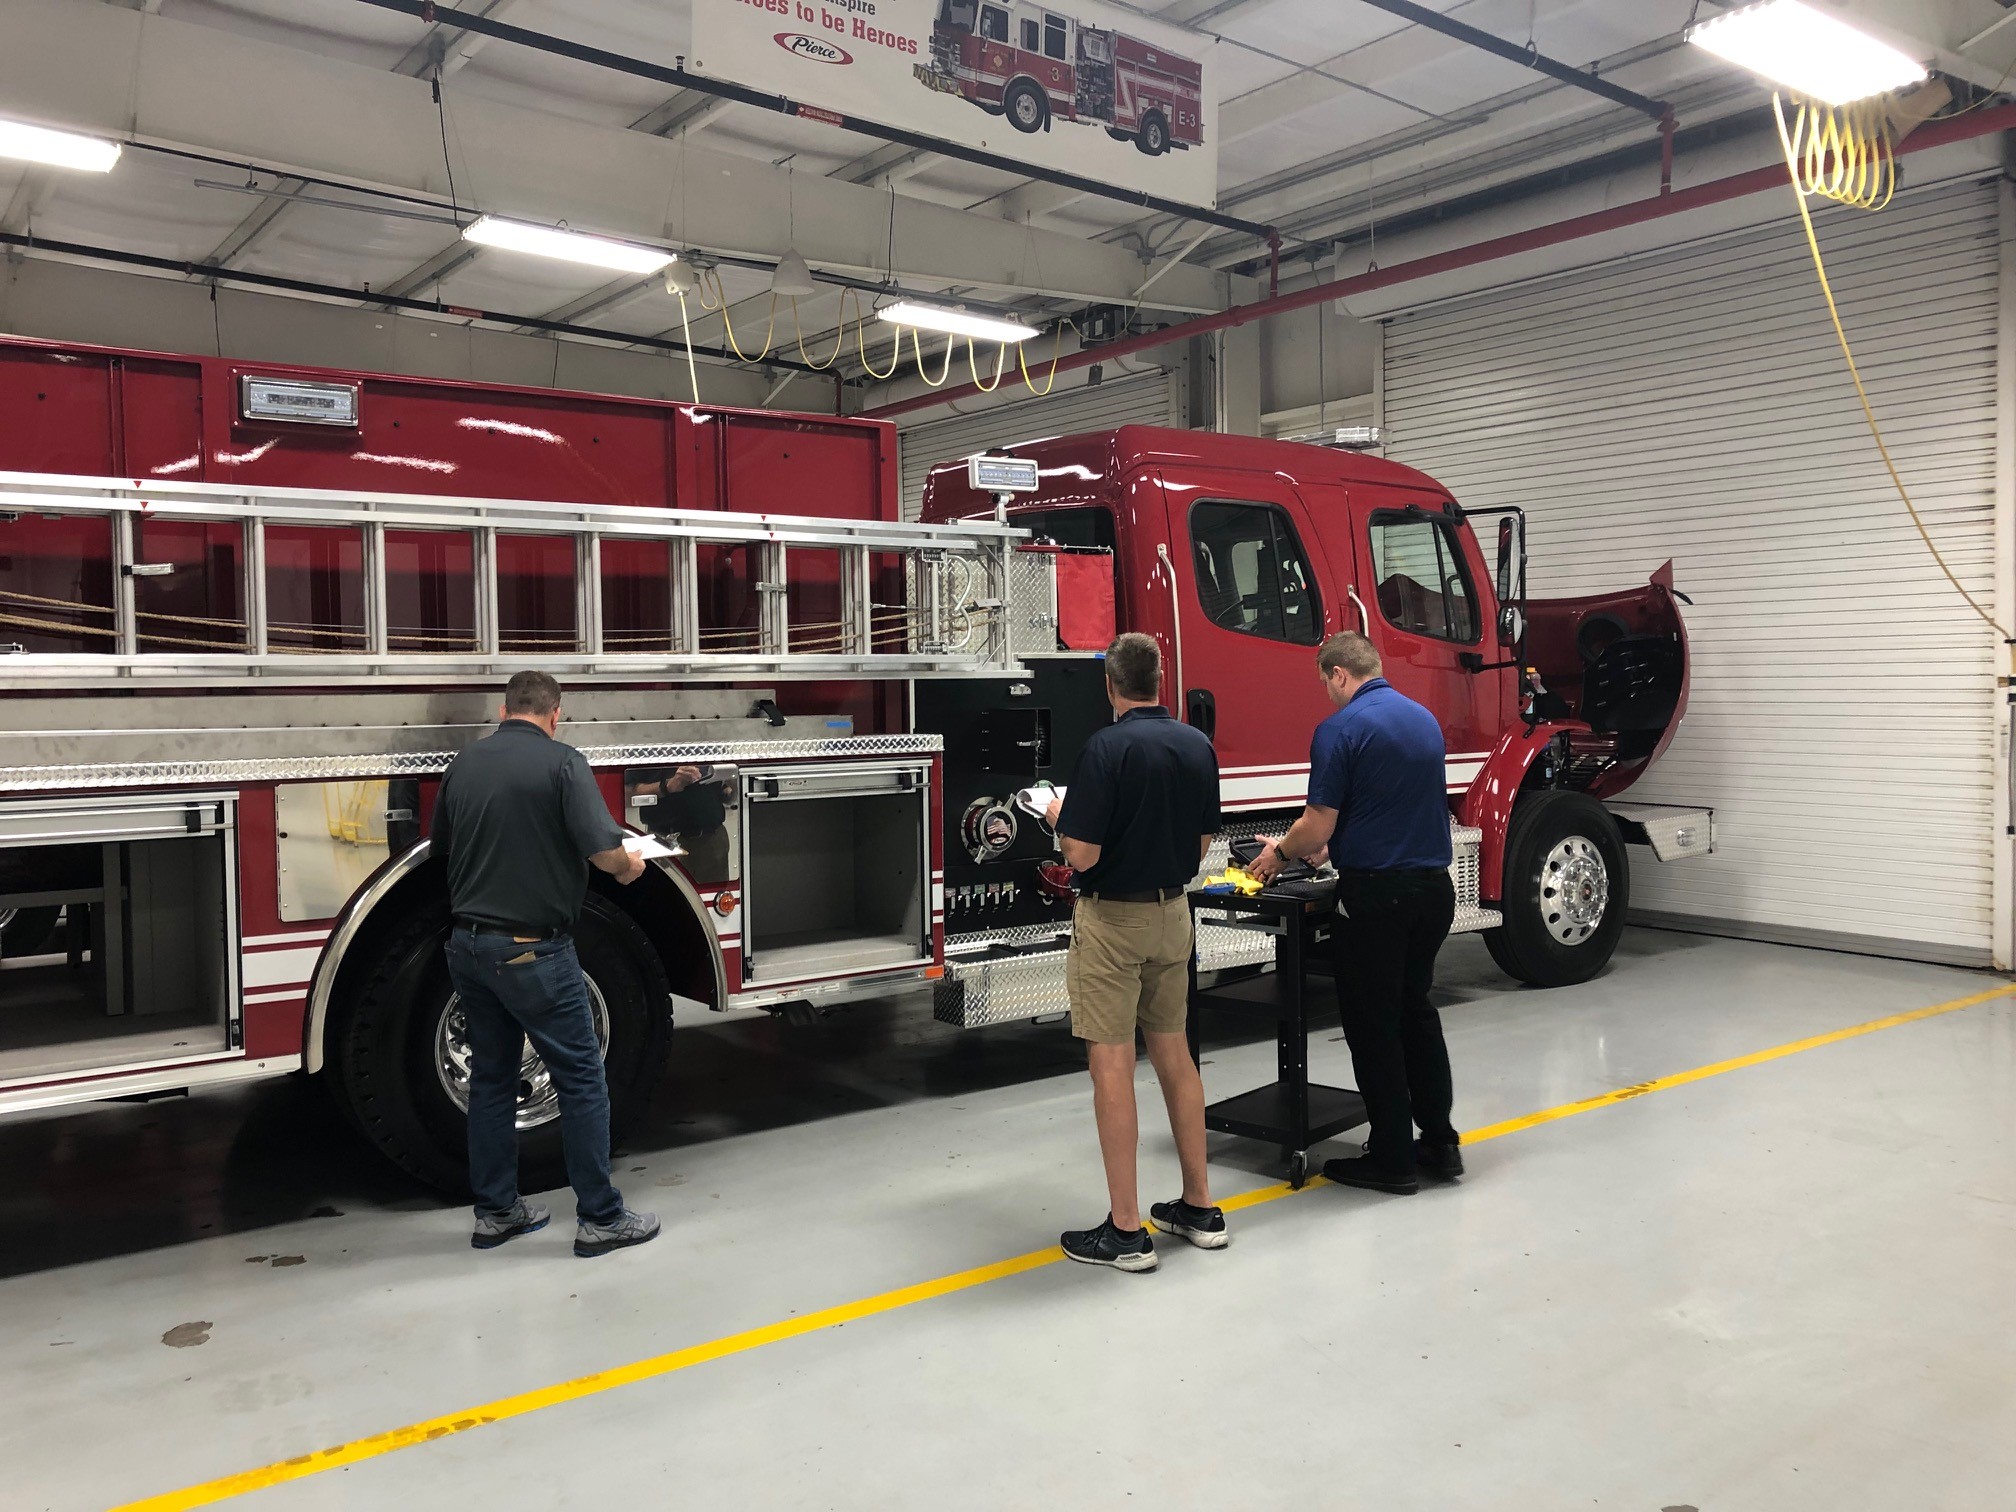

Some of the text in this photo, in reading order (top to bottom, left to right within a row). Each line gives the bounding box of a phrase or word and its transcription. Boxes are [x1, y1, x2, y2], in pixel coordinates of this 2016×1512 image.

[796, 1, 814, 23] to
[821, 7, 845, 33] be
[852, 17, 918, 55] Heroes
[791, 36, 836, 59] Pierce
[1179, 110, 1196, 127] E-3
